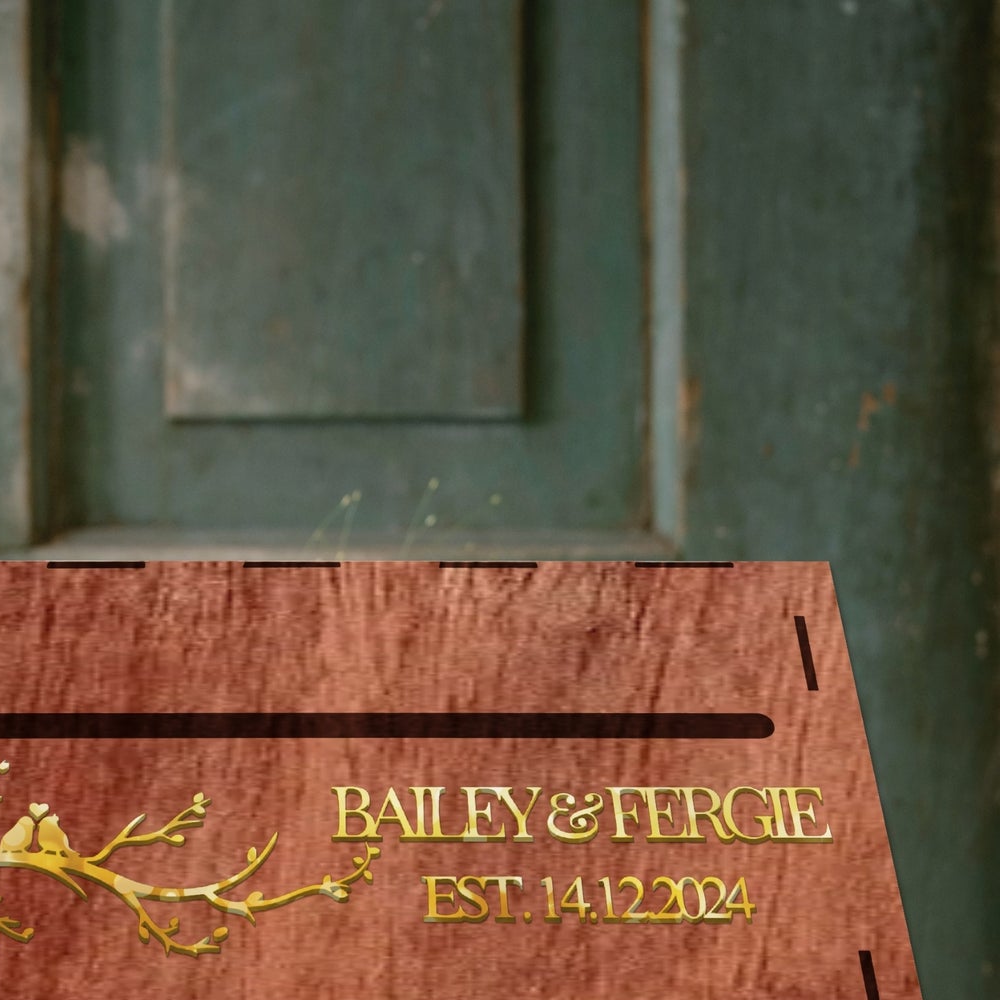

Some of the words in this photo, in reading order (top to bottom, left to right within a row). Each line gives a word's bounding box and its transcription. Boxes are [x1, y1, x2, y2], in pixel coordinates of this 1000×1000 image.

[331, 785, 541, 842] BAILEY
[546, 792, 604, 843] &
[608, 785, 834, 843] FERGIE
[421, 874, 532, 923] EST.
